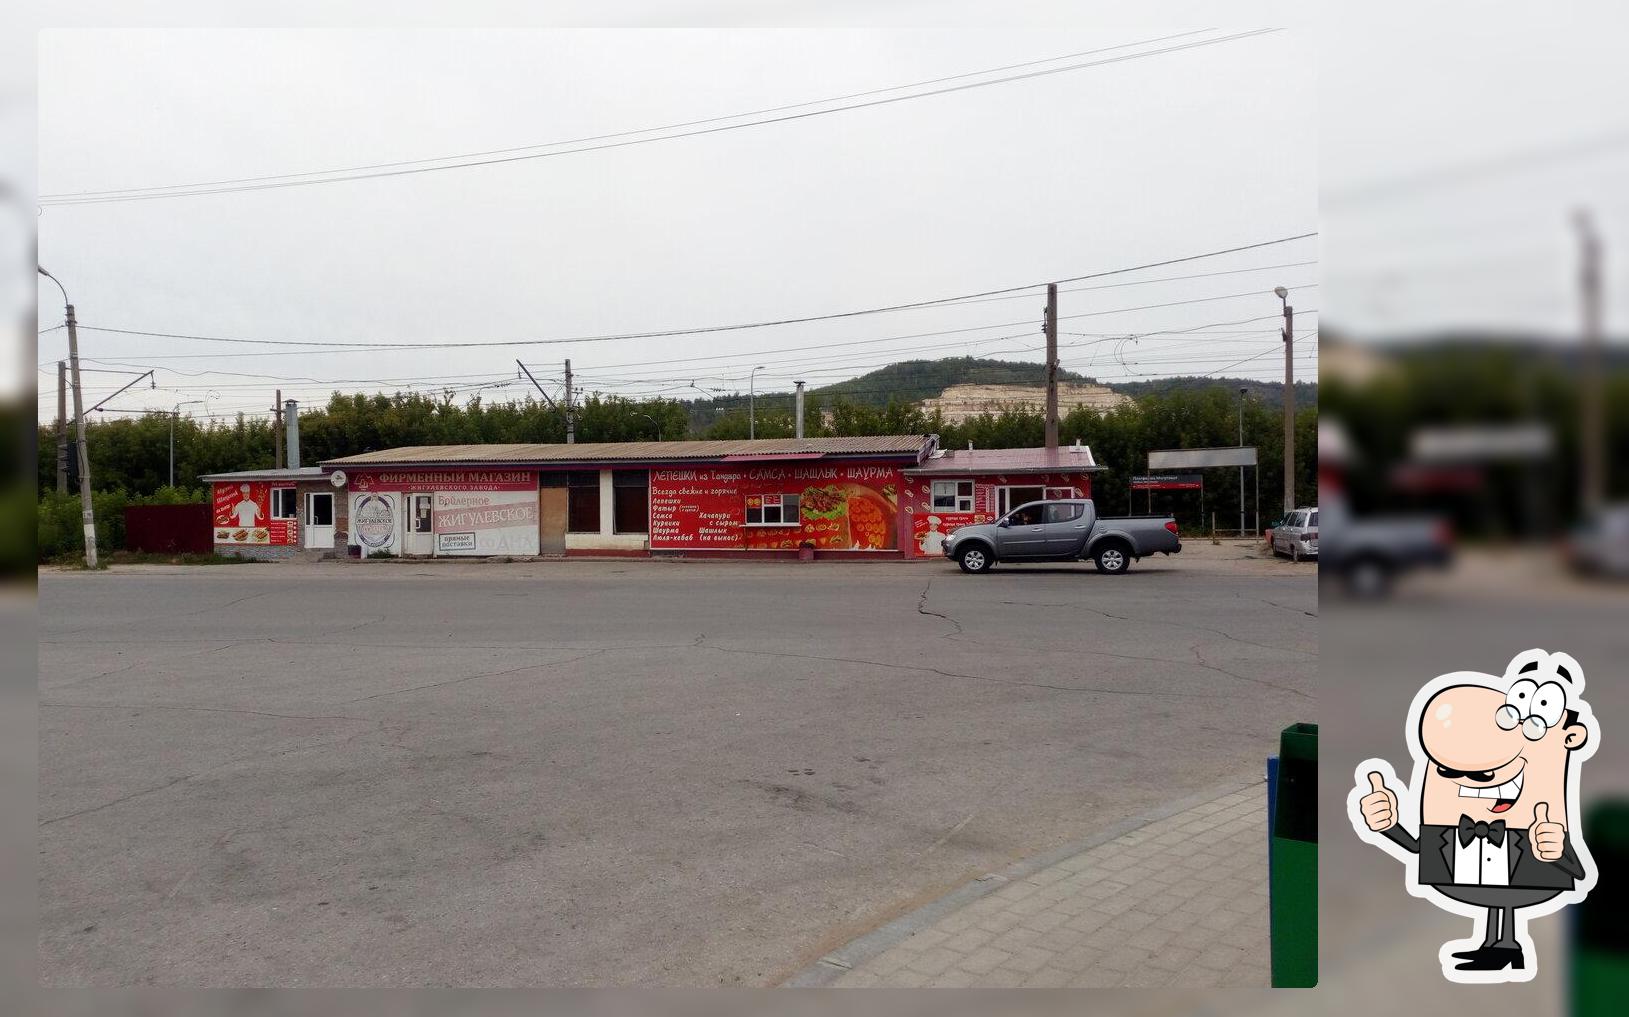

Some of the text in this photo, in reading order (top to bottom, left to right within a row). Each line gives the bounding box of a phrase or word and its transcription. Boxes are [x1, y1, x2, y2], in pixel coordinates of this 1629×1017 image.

[379, 471, 531, 482] ФИРМЕННЫЙ МАГАЗИН
[653, 470, 698, 481] ЛЕПЕШКИ
[750, 468, 786, 480] САМСА
[794, 468, 838, 479] ШАШЛЫК
[847, 467, 893, 480] ШАУРМА
[652, 487, 677, 497] Всегда
[678, 486, 702, 495] свежие
[710, 488, 737, 497] горячие
[438, 506, 533, 528] ЖИГУЛЕВСКОЕ
[699, 512, 731, 520] Хачапури
[652, 527, 679, 535] Шаурма
